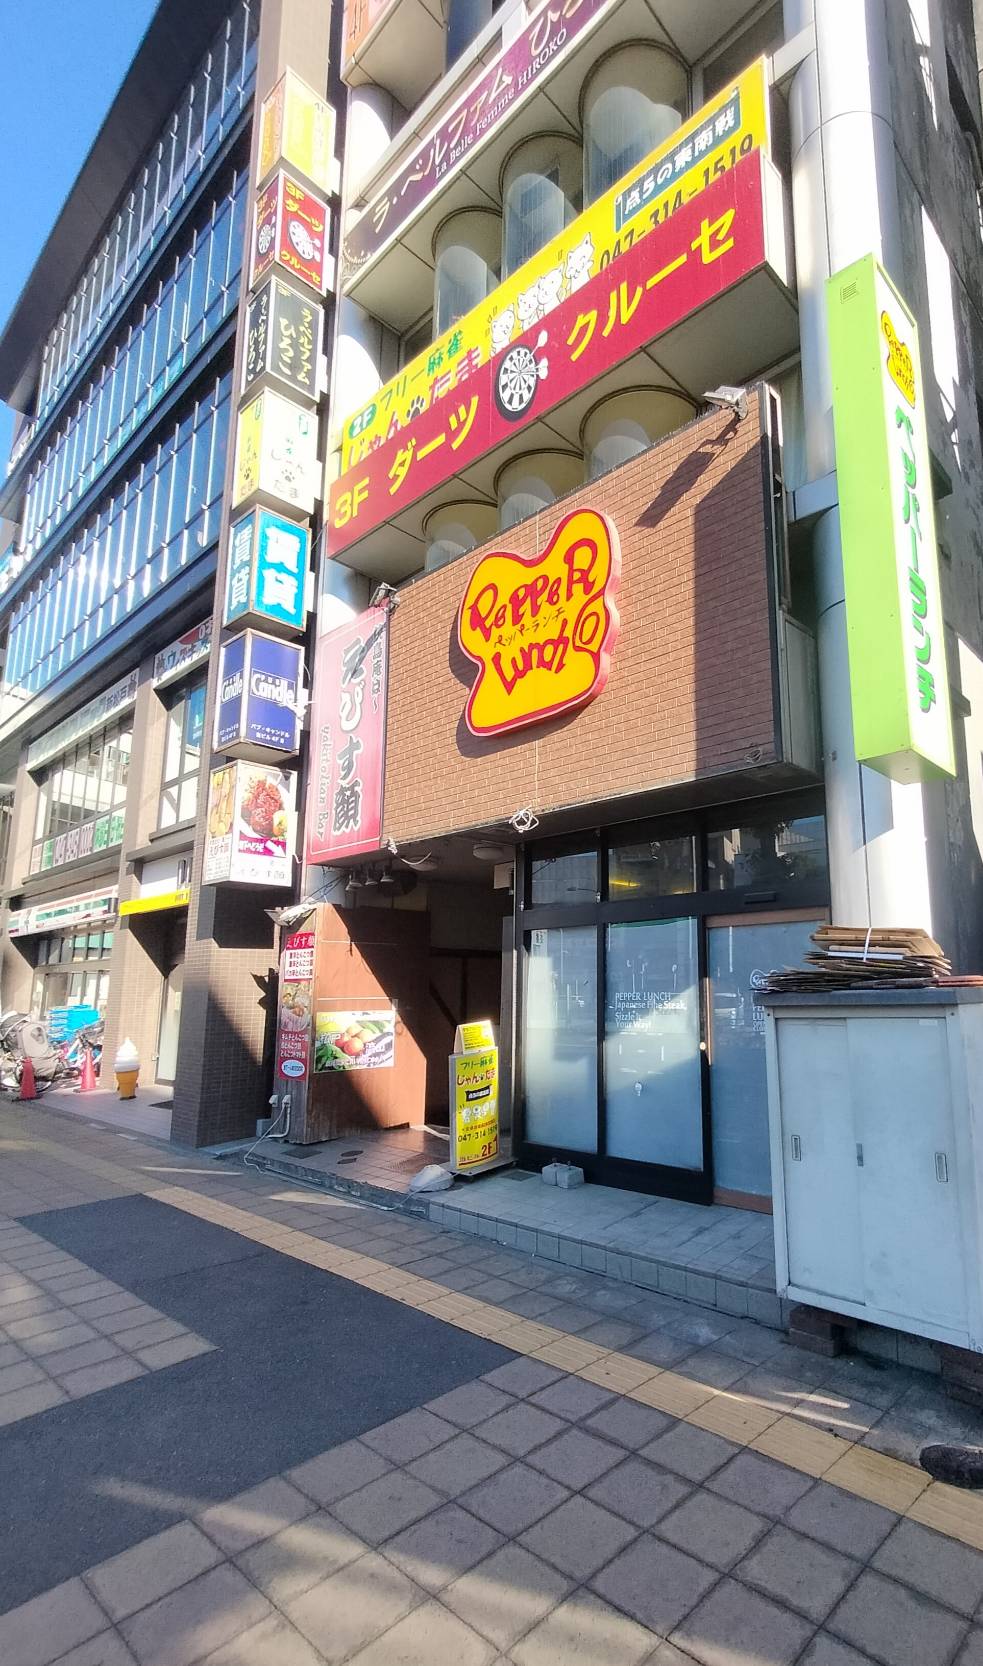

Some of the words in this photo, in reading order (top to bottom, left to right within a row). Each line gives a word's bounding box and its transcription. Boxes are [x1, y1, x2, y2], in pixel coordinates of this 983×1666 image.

[435, 158, 447, 180] La
[449, 133, 474, 164] Belle
[476, 86, 516, 136] Femme
[517, 27, 568, 90] HIROKO
[566, 208, 737, 362] クルーセ
[352, 405, 374, 438] 2F
[388, 395, 480, 497] ダーツ
[334, 477, 370, 529] 3F
[230, 523, 253, 612] 賃貸
[251, 672, 296, 706] Candle
[614, 1000, 646, 1012] Japanese
[615, 991, 641, 1001] PEPPER
[643, 991, 671, 1001] LUNCH
[614, 1010, 635, 1021] Sizzle
[481, 1141, 493, 1157] 2F
